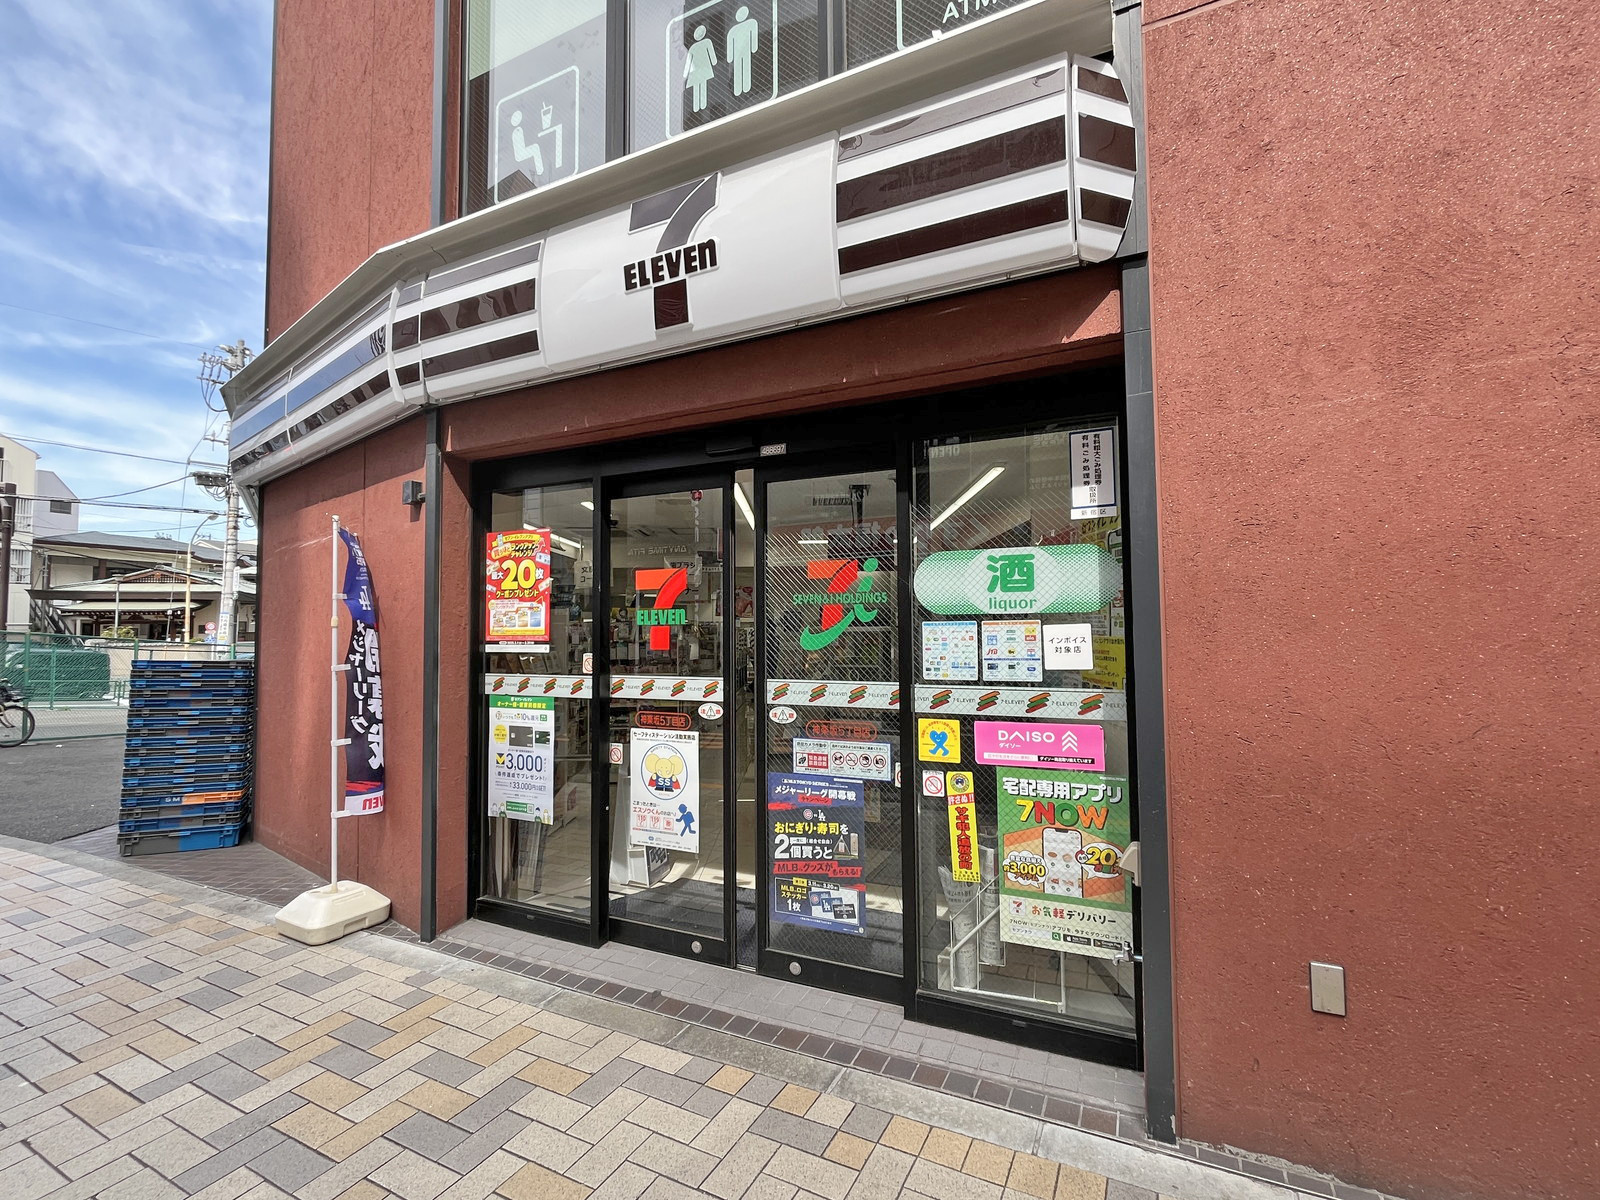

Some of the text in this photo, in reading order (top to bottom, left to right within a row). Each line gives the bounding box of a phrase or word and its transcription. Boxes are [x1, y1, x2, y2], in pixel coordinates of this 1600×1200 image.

[986, 553, 1036, 593] 酒
[988, 596, 1038, 611] liquor
[1048, 636, 1087, 645] インボイス
[1054, 645, 1082, 654] 対象店
[997, 729, 1056, 743] DAISO
[505, 752, 543, 773] 3,000
[657, 777, 671, 787] SS
[774, 785, 857, 802] メジャーリーグ開幕戦
[1002, 776, 1123, 804] 宅配専用アプリ
[1015, 798, 1110, 830] 7NOW
[774, 821, 849, 835] おにぎり・寿司を
[780, 891, 807, 900] ステッカー
[786, 898, 801, 912] 1枚
[1031, 904, 1117, 925] お気軽デリバリー
